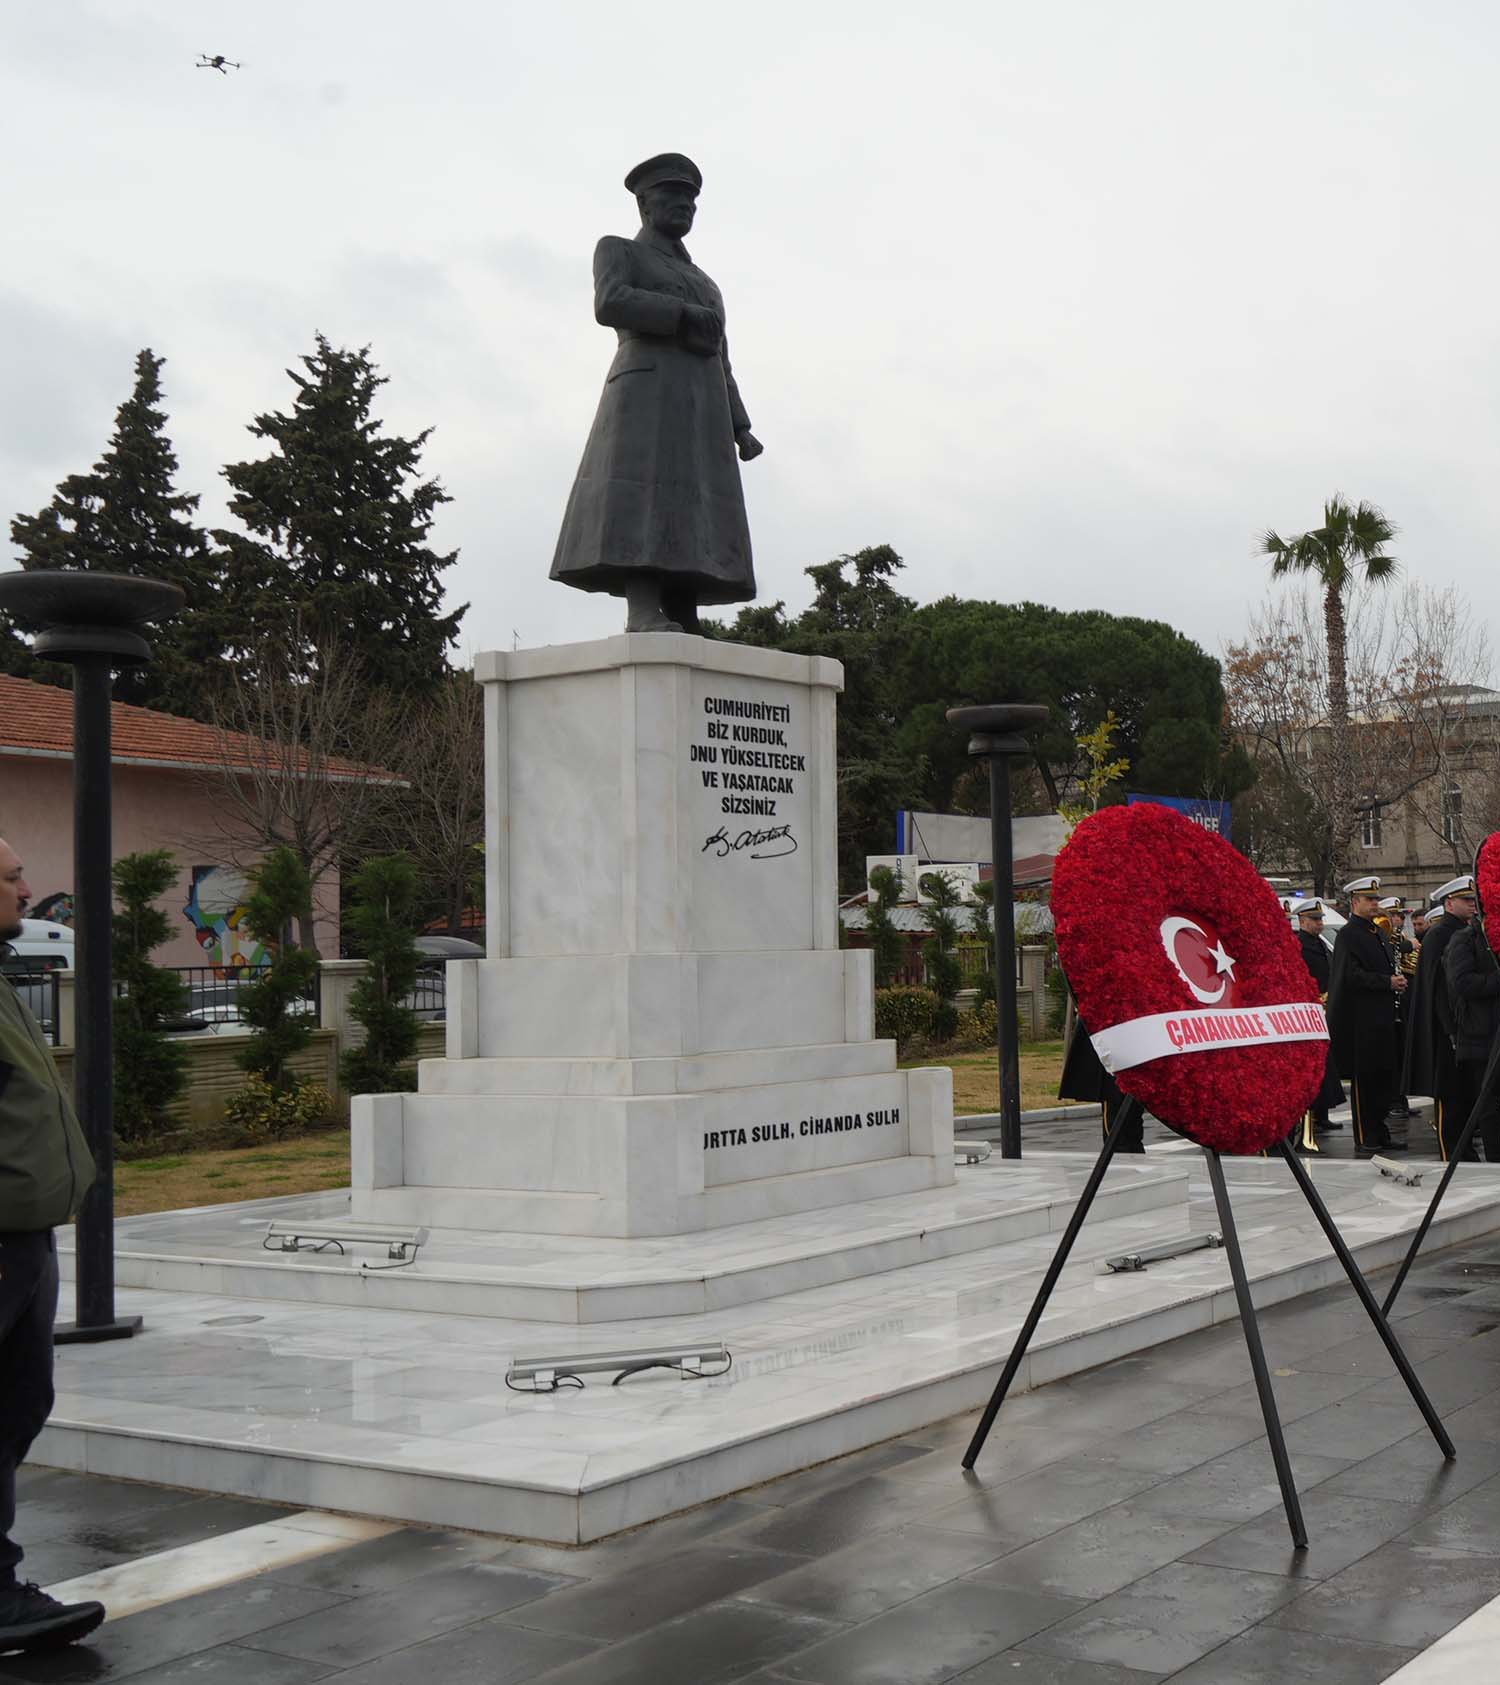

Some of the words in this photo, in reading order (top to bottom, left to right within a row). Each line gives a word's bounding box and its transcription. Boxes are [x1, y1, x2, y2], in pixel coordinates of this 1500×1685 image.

[704, 697, 790, 723] CUMHURİYETİ
[707, 720, 729, 740] BİZ
[733, 724, 788, 748] KURDUK,
[690, 744, 717, 763] ONU
[721, 745, 805, 772] YÜKSELTECEK
[702, 771, 718, 788] VE
[722, 772, 794, 792] YAŞATACAK
[721, 793, 776, 816] SİZSİNİZ
[1166, 1013, 1269, 1051] ÇANAKKALE
[1265, 1004, 1328, 1035] VALİLİĞİ
[751, 1122, 795, 1143] SULH,
[799, 1114, 863, 1136] CİHANDA
[866, 1108, 900, 1127] SULH
